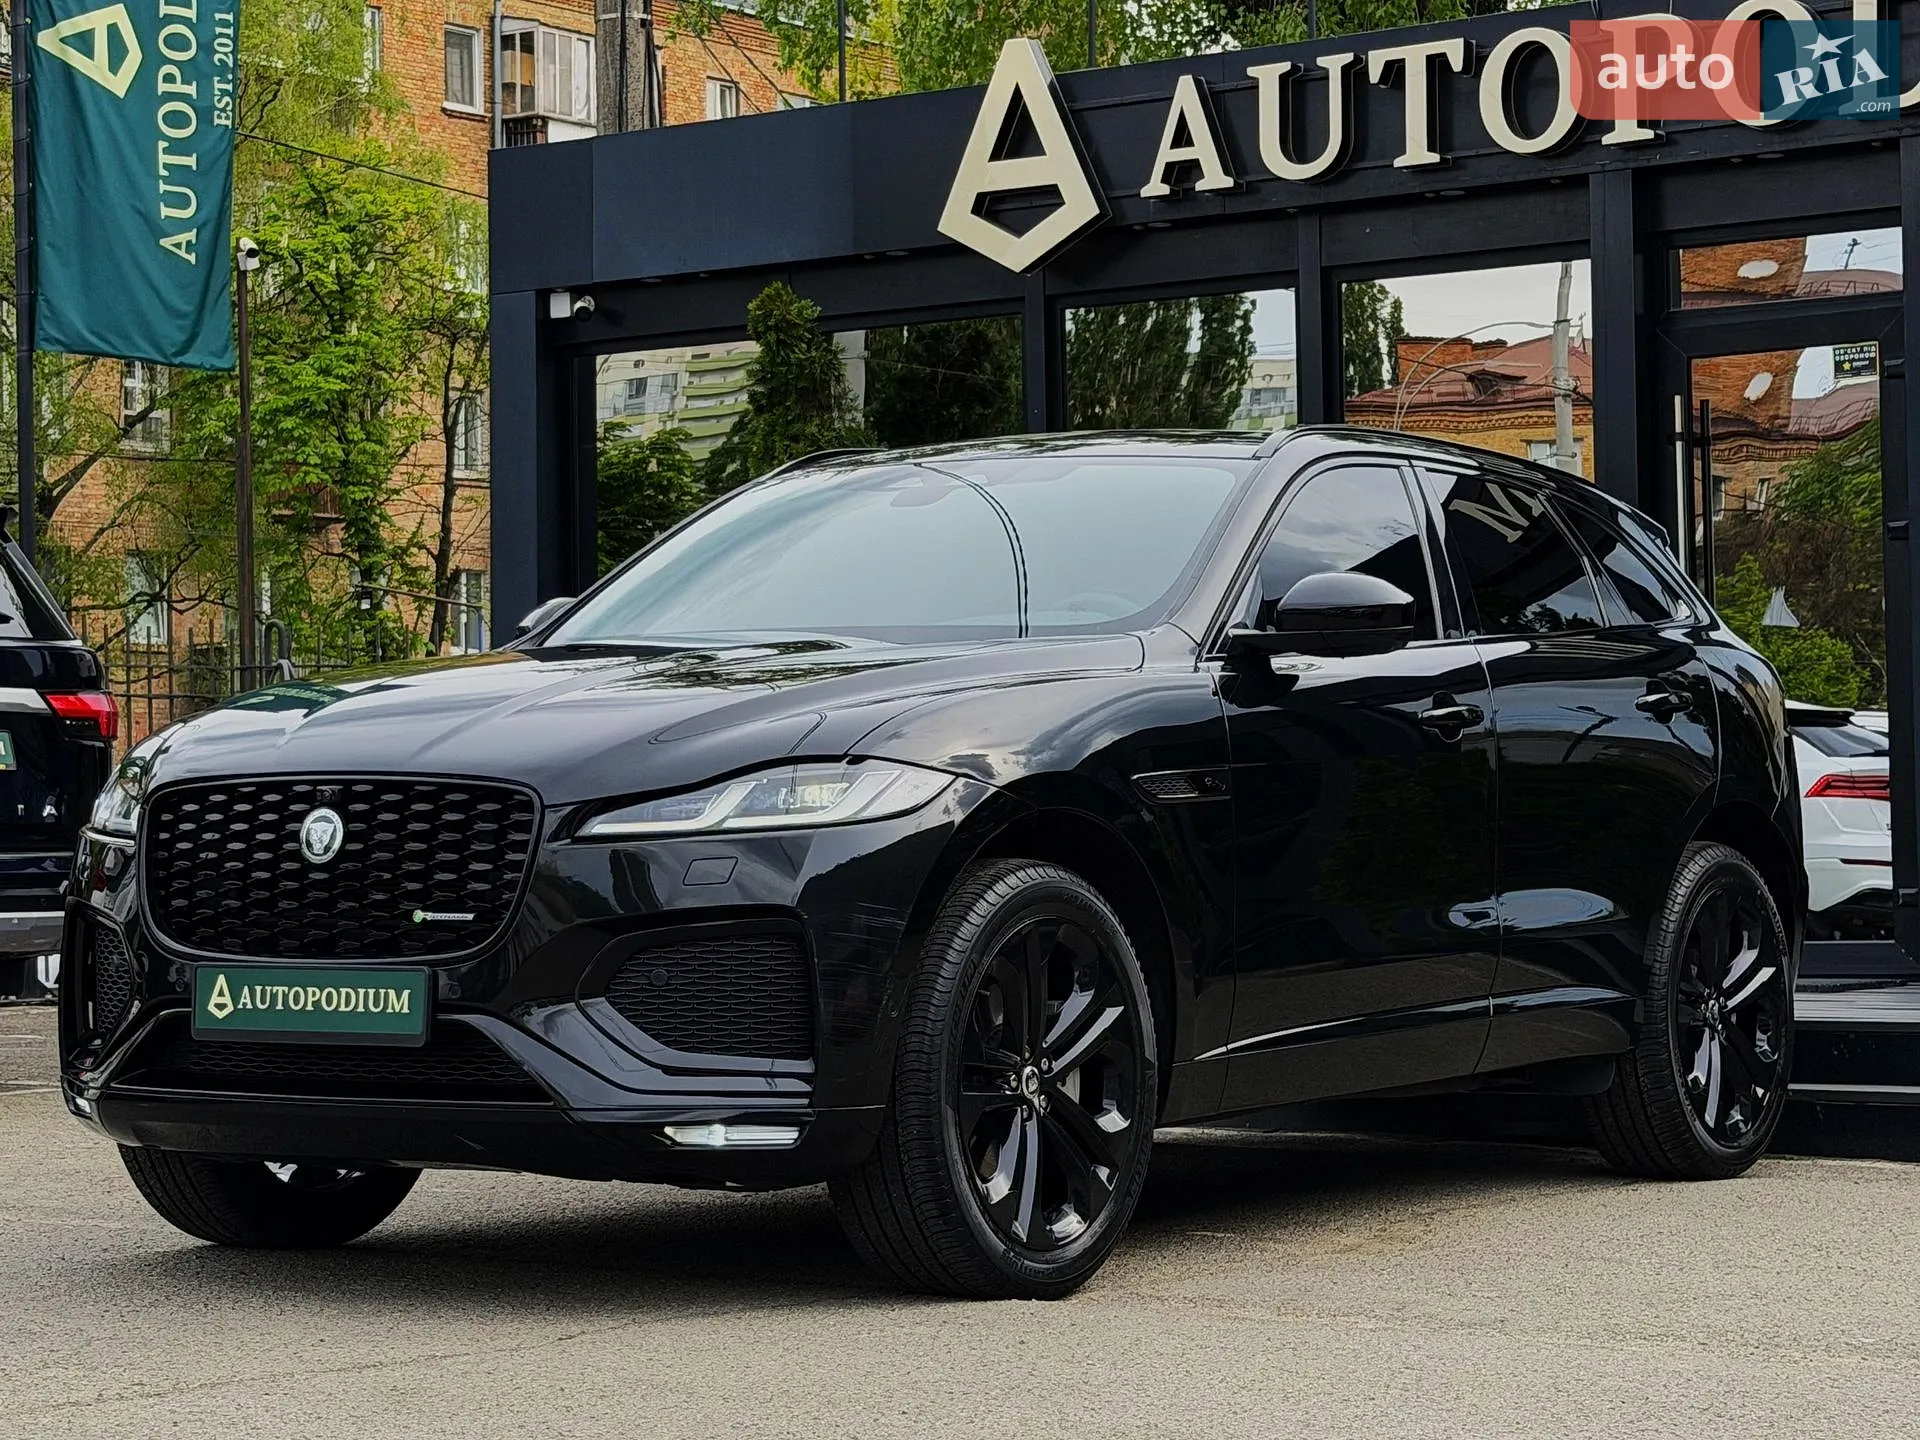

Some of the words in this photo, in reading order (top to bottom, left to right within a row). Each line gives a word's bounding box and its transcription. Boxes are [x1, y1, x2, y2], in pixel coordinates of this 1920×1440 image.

[213, 12, 234, 68] 2011
[213, 73, 233, 129] EST.
[237, 985, 412, 1014] AUTOPODIUM
